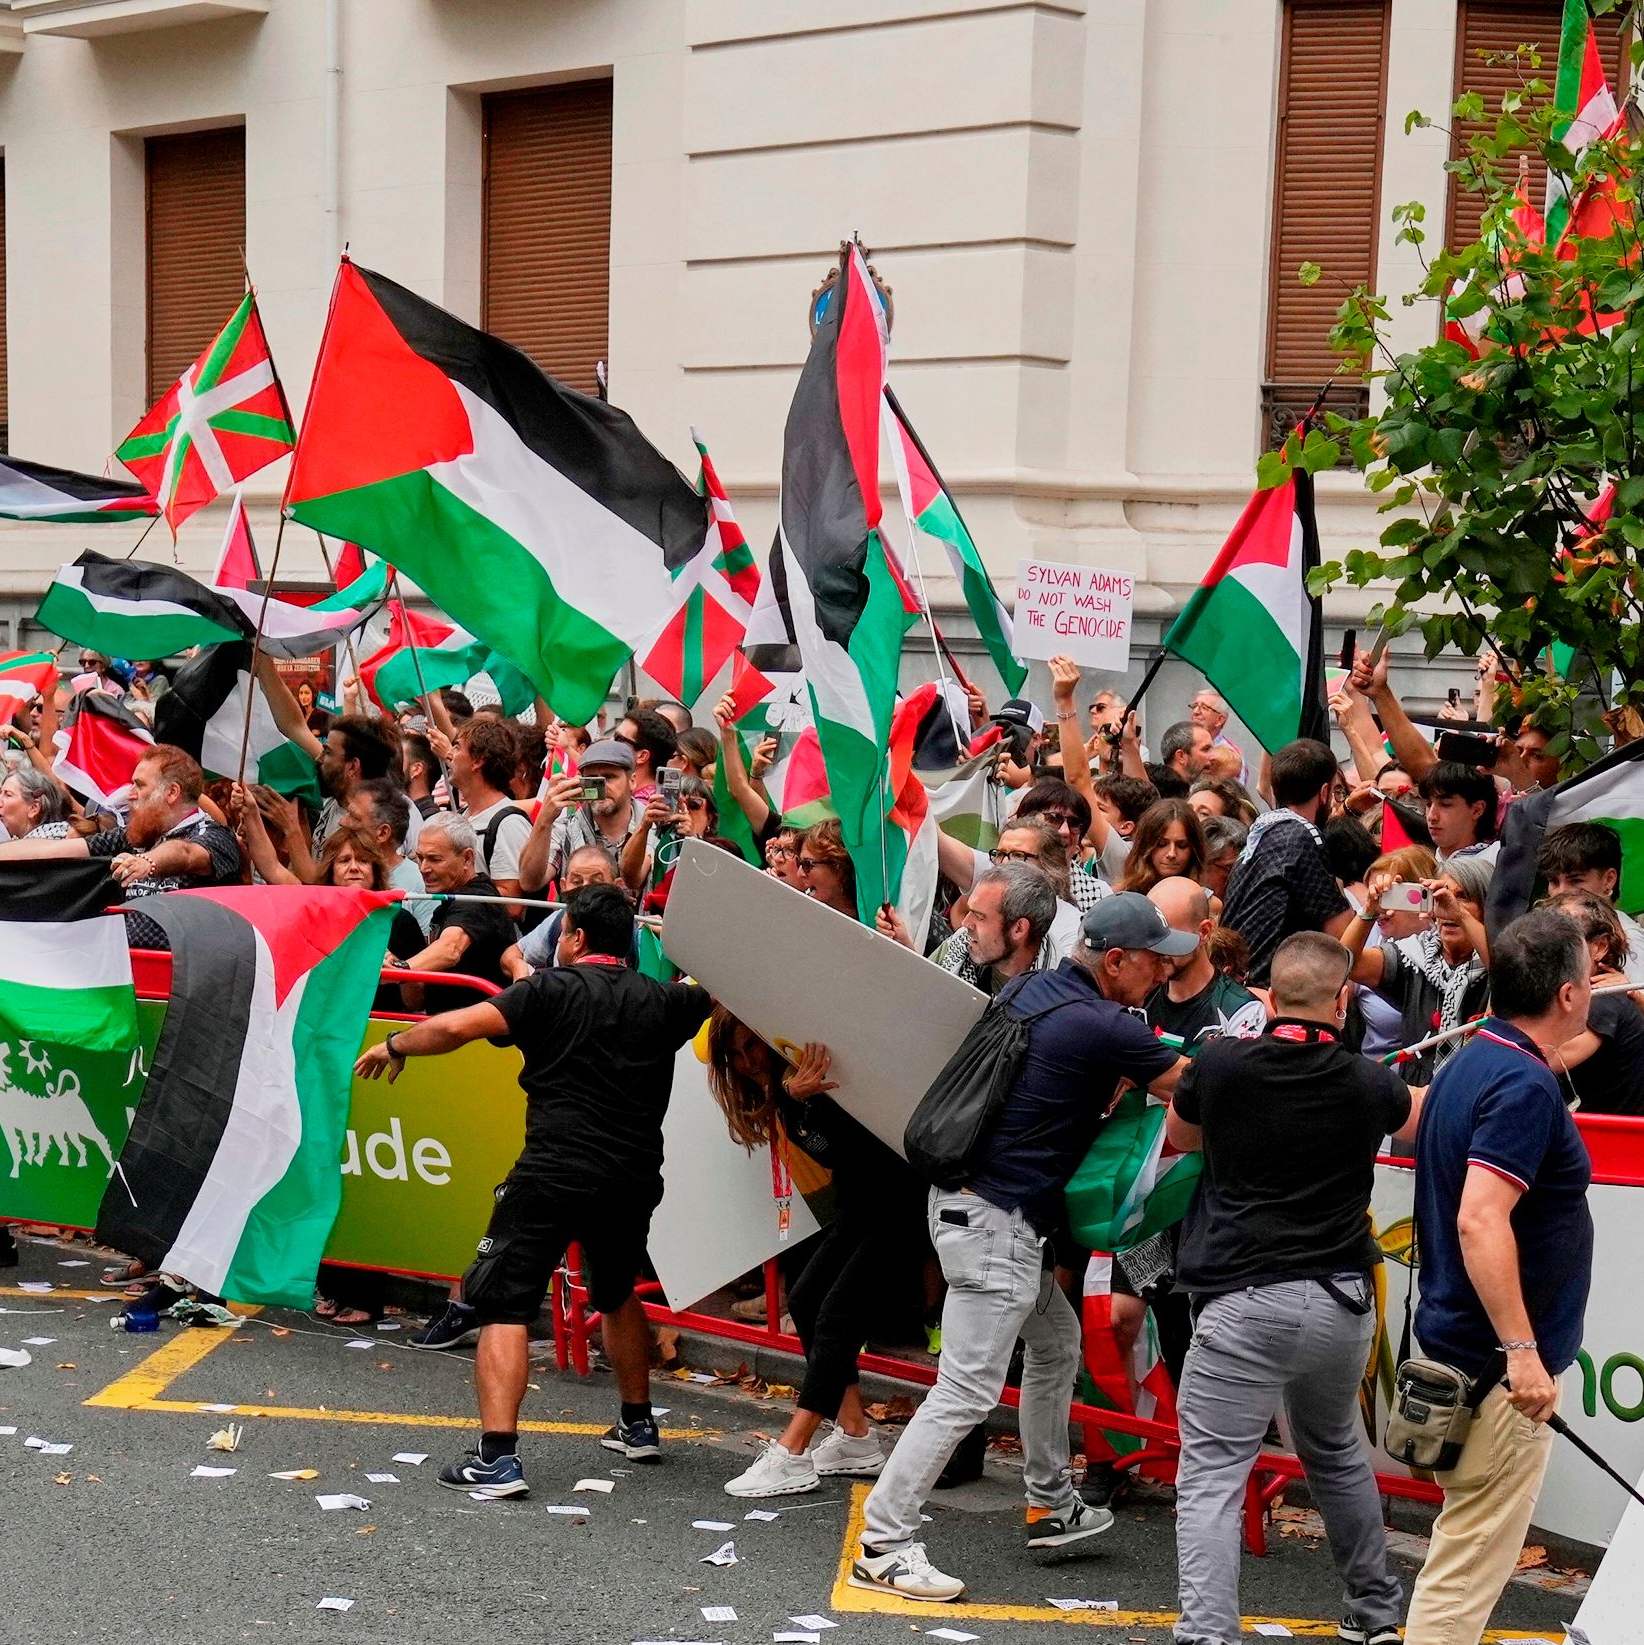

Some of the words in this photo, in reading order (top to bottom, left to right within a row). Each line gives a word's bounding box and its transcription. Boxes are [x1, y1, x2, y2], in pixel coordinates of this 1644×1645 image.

[1027, 565, 1081, 588] SYLVAN
[1089, 573, 1132, 600] ADAMS,
[1018, 587, 1031, 601] DO
[1039, 592, 1066, 606] NOT
[1074, 593, 1112, 613] WASH
[1027, 610, 1046, 627] THE
[1054, 610, 1126, 639] GENOCIDE
